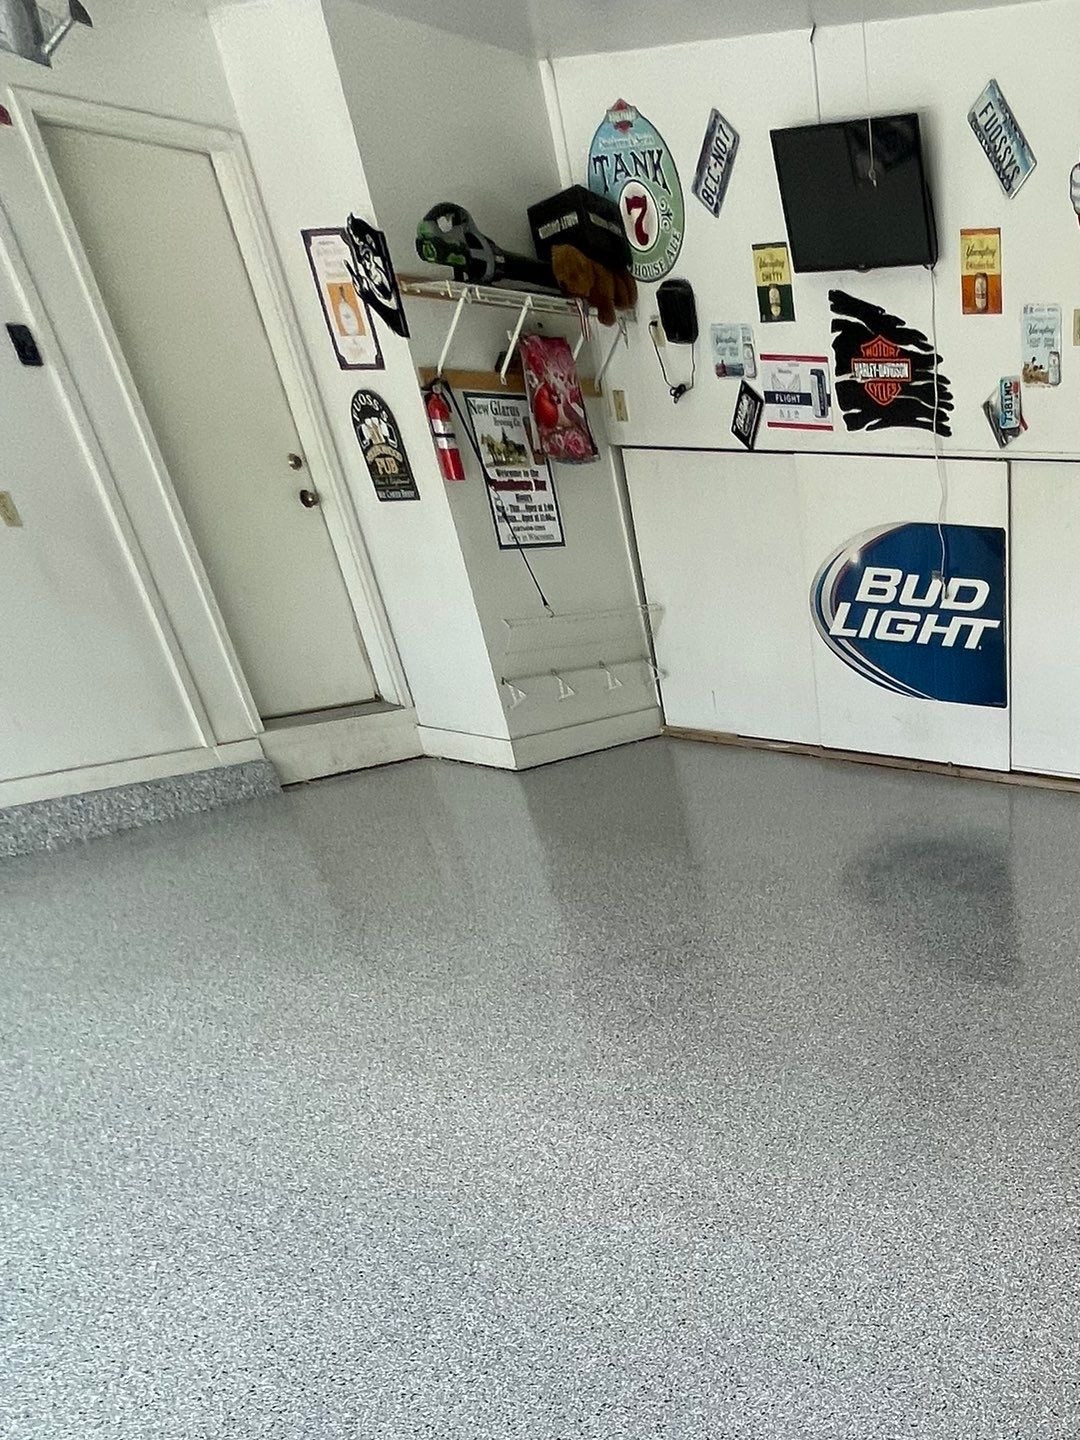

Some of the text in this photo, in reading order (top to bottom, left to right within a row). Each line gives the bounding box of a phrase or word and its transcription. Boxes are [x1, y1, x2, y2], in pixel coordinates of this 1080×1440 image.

[979, 101, 1021, 186] FUOSSYS
[593, 148, 672, 196] TANK
[625, 194, 649, 246] 7
[866, 341, 896, 357] MOTOR
[469, 399, 520, 417] New Glarus
[775, 393, 801, 404] FLIGHT
[868, 382, 897, 402] CYCLES
[375, 457, 399, 474] PUB
[855, 567, 990, 611] BUD
[829, 602, 1001, 650] LIGHT
